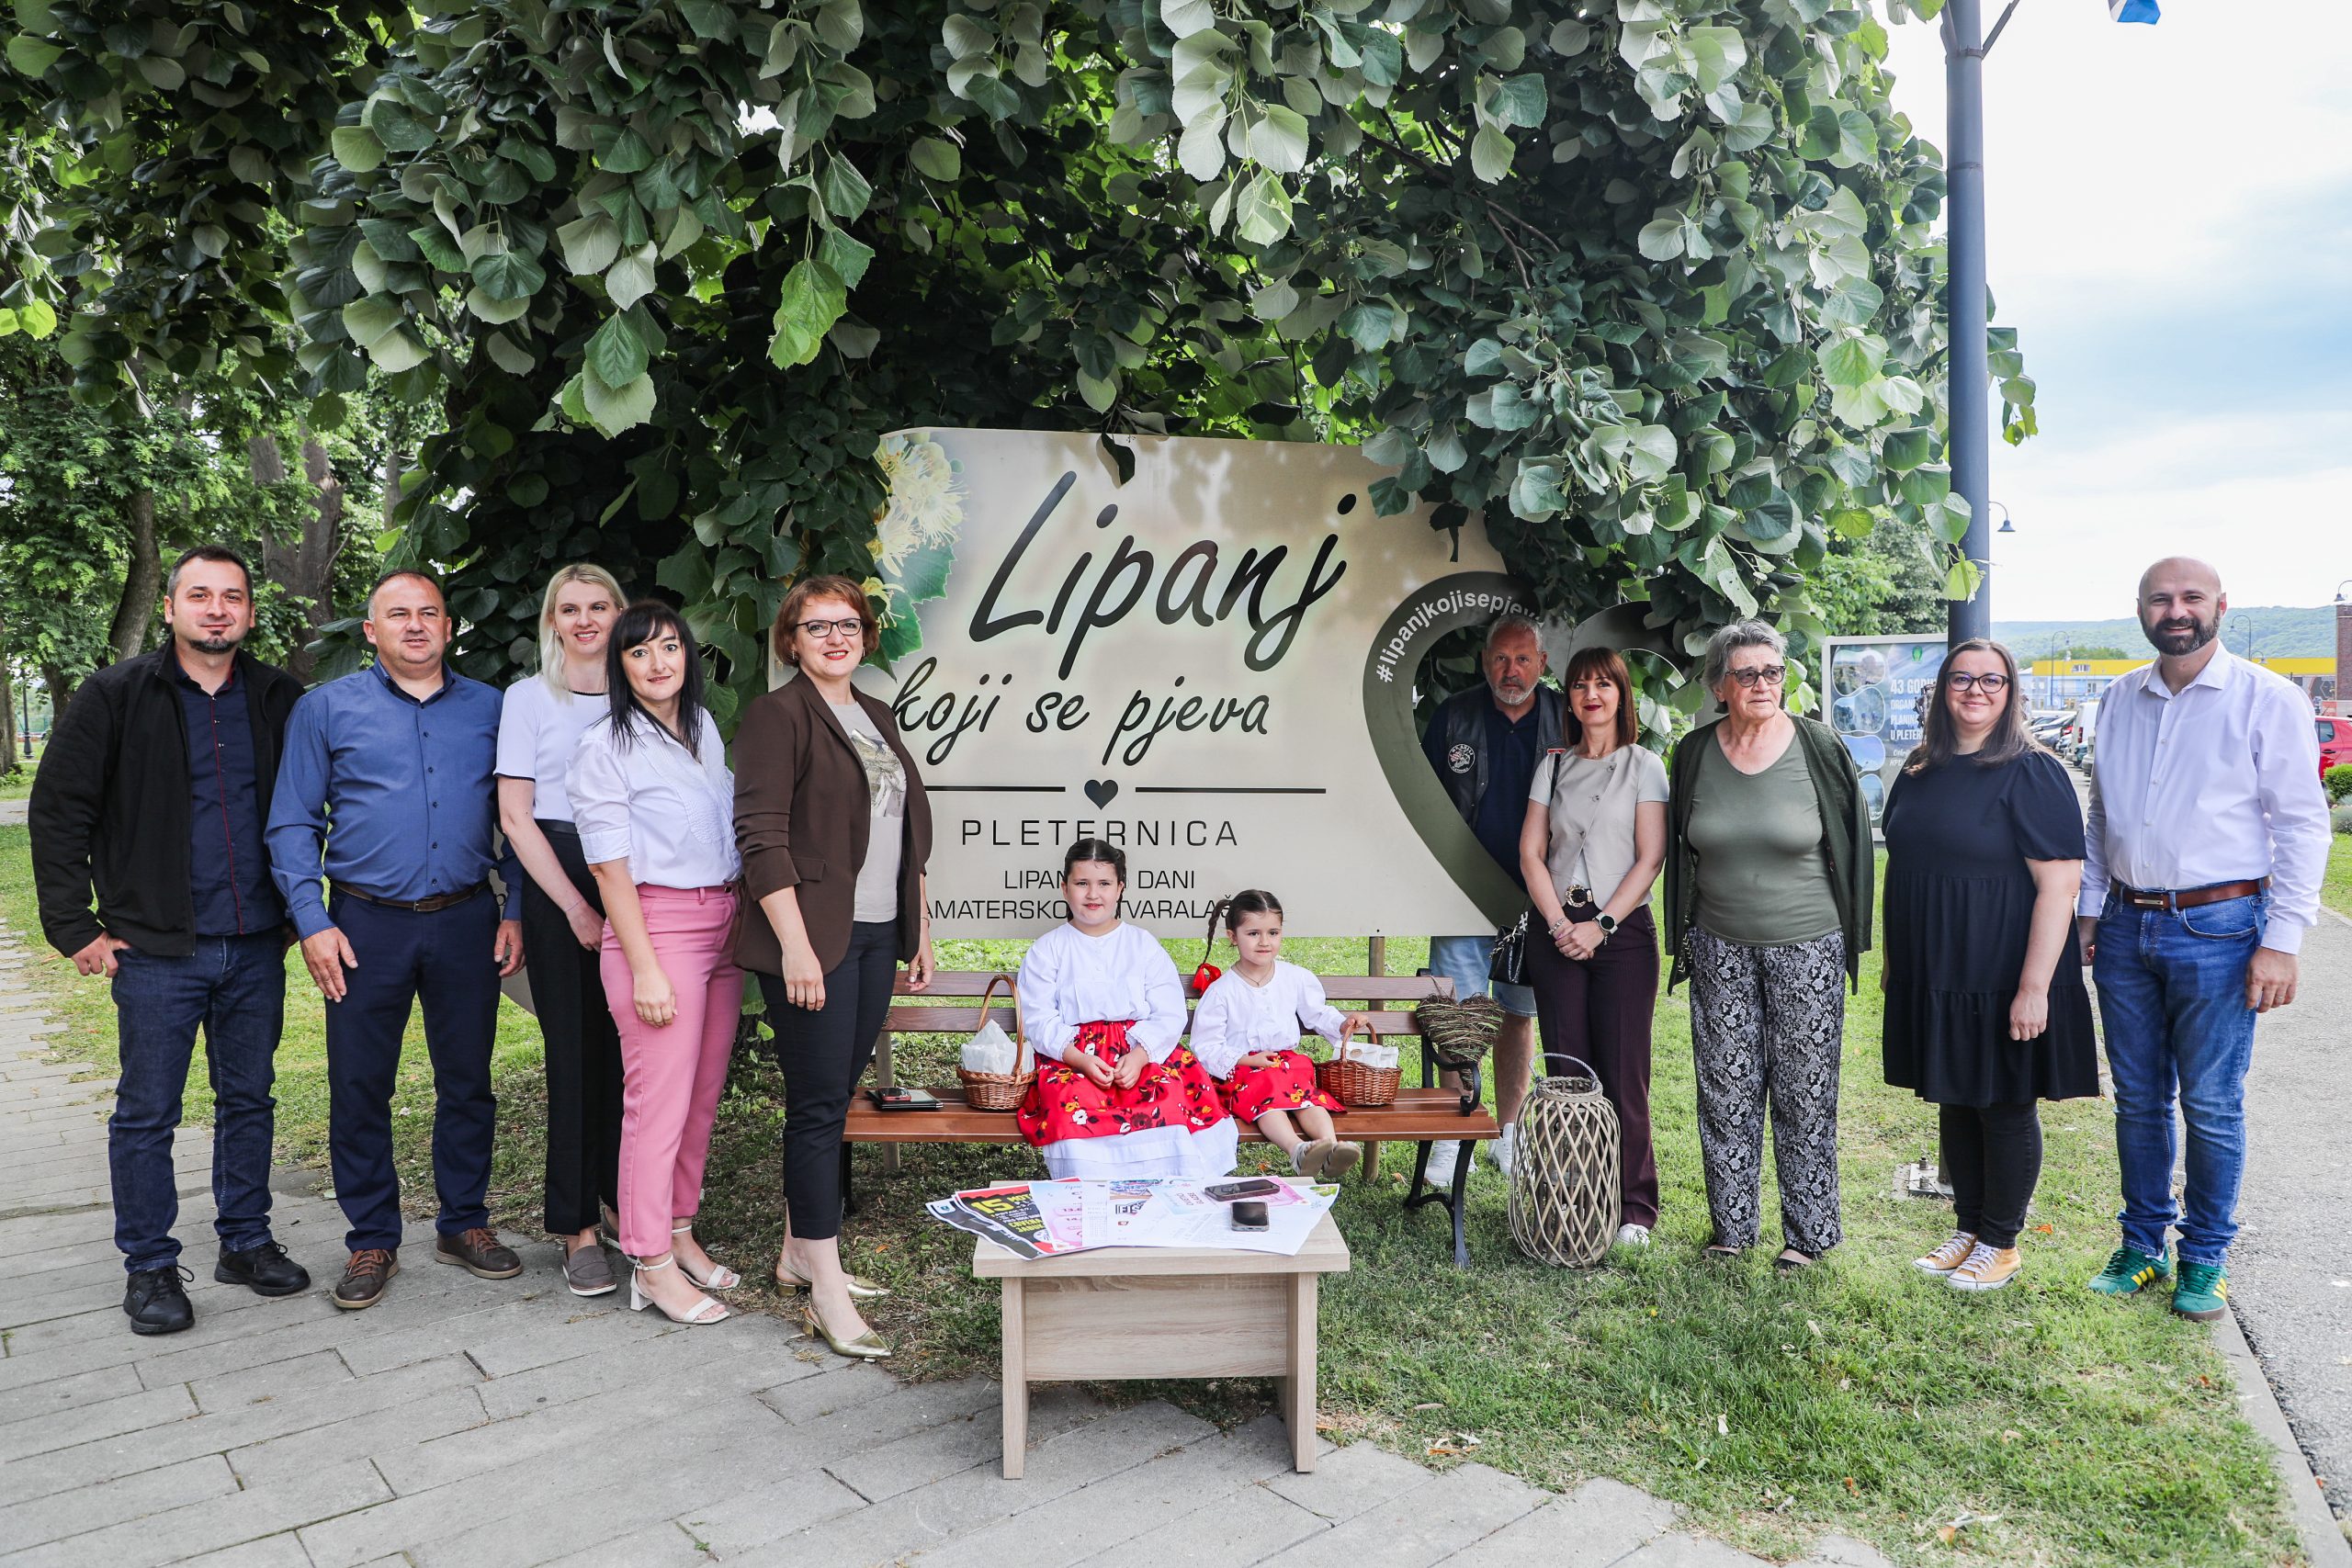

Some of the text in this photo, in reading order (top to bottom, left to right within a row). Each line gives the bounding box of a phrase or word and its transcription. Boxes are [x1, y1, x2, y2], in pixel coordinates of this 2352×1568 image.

[969, 470, 1357, 682] Lipanj
[1376, 590, 1541, 683] #lipanjkojisepjev
[1890, 679, 1905, 695] 43
[891, 656, 1270, 766] koji se pjeva
[962, 819, 1238, 847] PLETERNICA
[1137, 869, 1195, 890] DANI
[926, 899, 1069, 920] AMATERSKO
[971, 1198, 1014, 1213] 15
[1007, 1193, 1033, 1202] MOT
